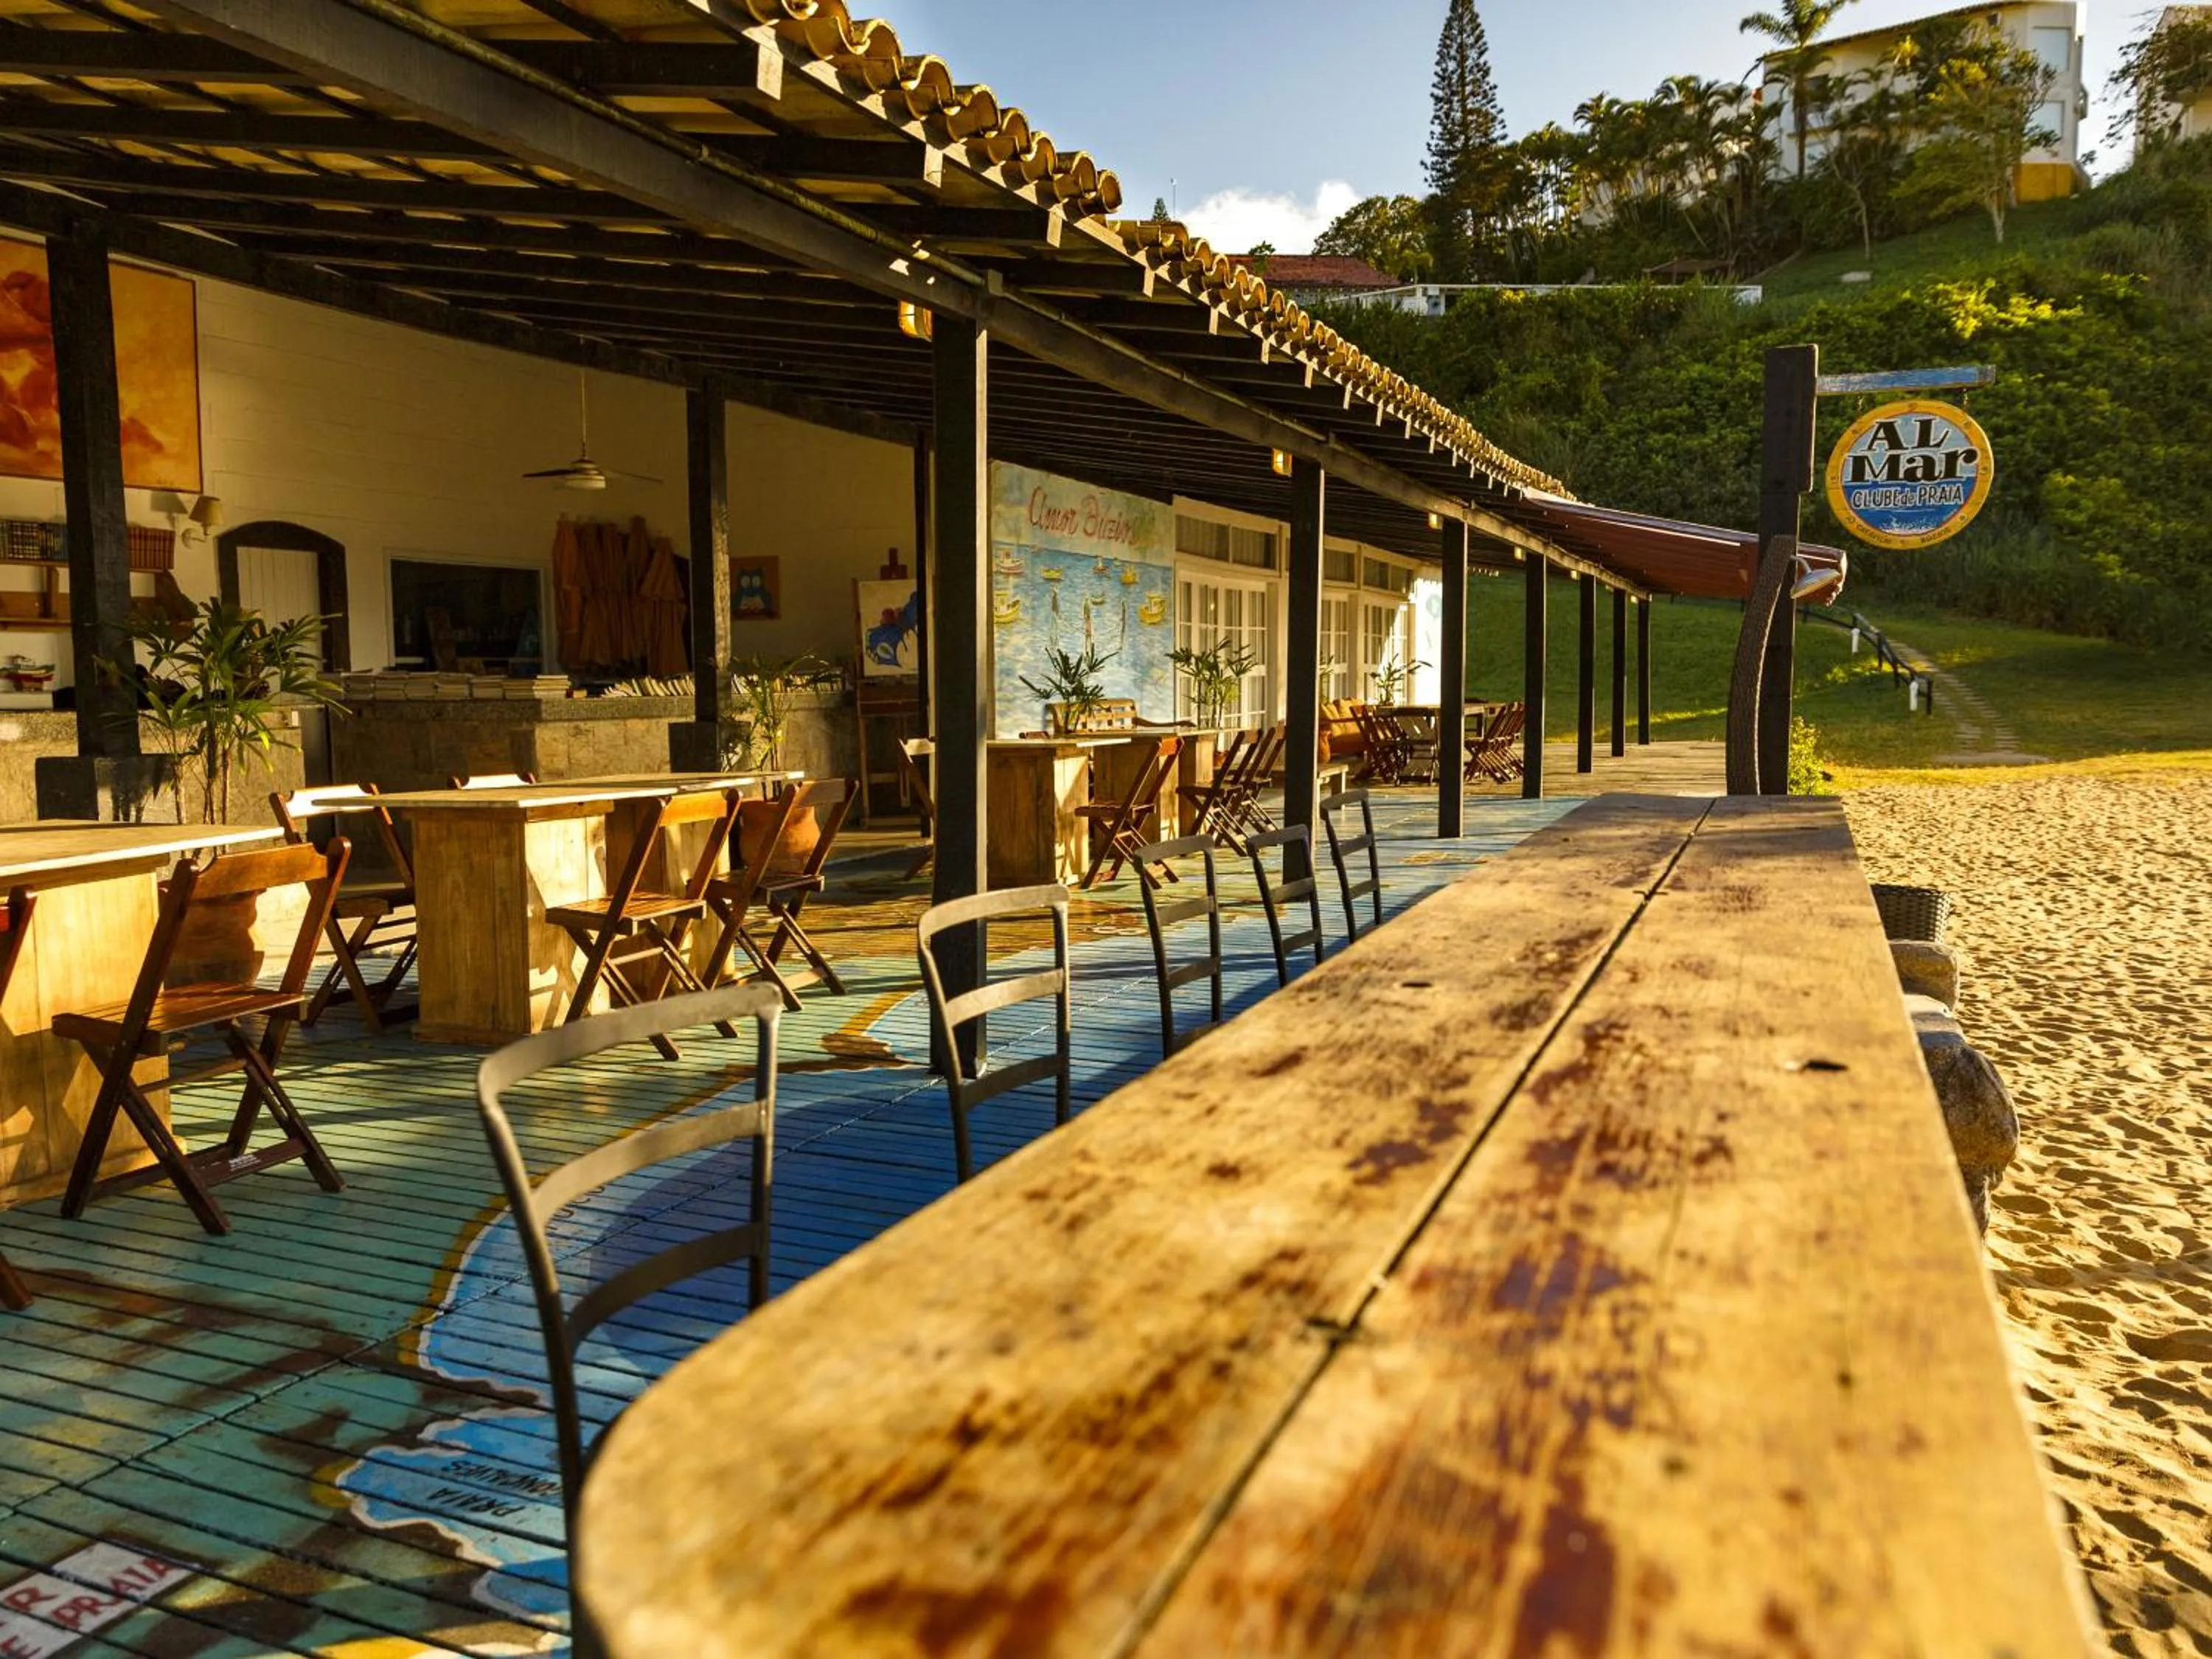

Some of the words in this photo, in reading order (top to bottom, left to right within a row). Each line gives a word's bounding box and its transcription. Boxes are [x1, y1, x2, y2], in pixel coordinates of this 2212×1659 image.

[1860, 417, 1951, 453] AL
[1846, 447, 1979, 483] Mar
[1029, 486, 1078, 535] Amor
[1851, 488, 1899, 509] CLUBE
[1899, 487, 1916, 507] de
[1917, 484, 1963, 506] PRAIA
[425, 1486, 526, 1517] PRAIA
[49, 1556, 177, 1630] PRAIA
